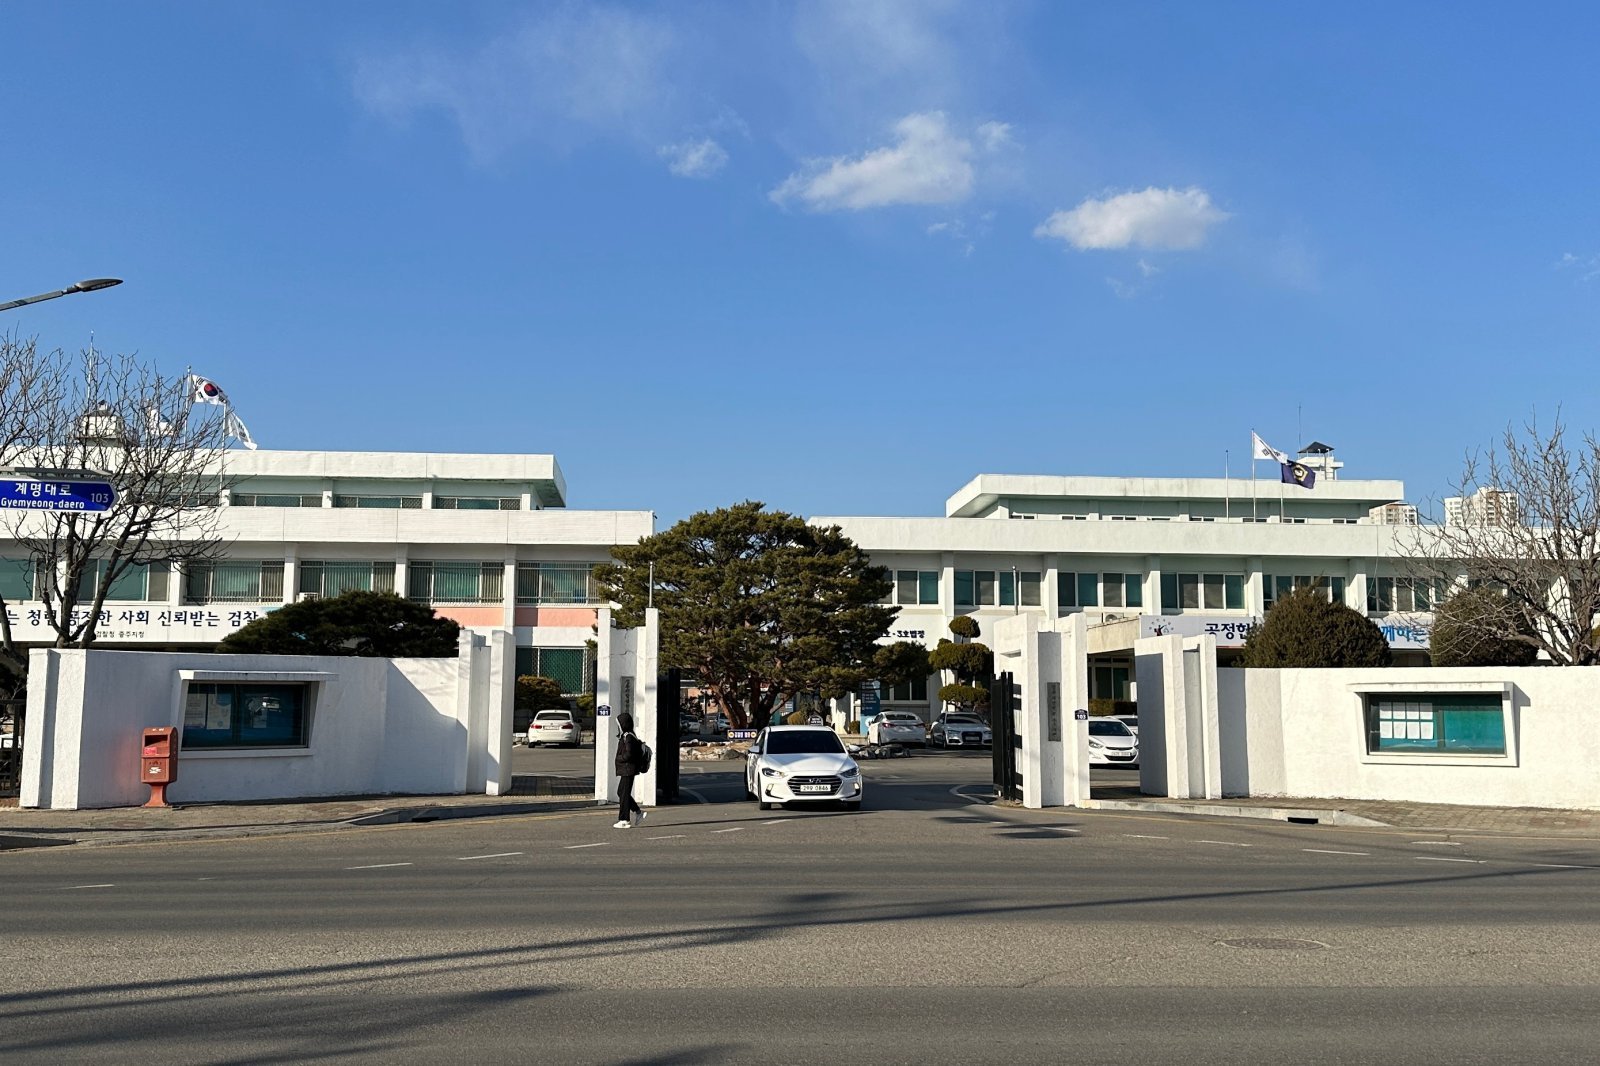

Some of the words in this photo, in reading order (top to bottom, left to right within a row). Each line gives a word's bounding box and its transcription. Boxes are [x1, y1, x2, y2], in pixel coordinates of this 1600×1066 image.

[15, 482, 71, 497] 계명대로
[1, 497, 85, 510] Gyemyeong-daero
[91, 493, 109, 503] 103
[118, 610, 149, 625] 사회
[157, 610, 220, 627] 신뢰받는
